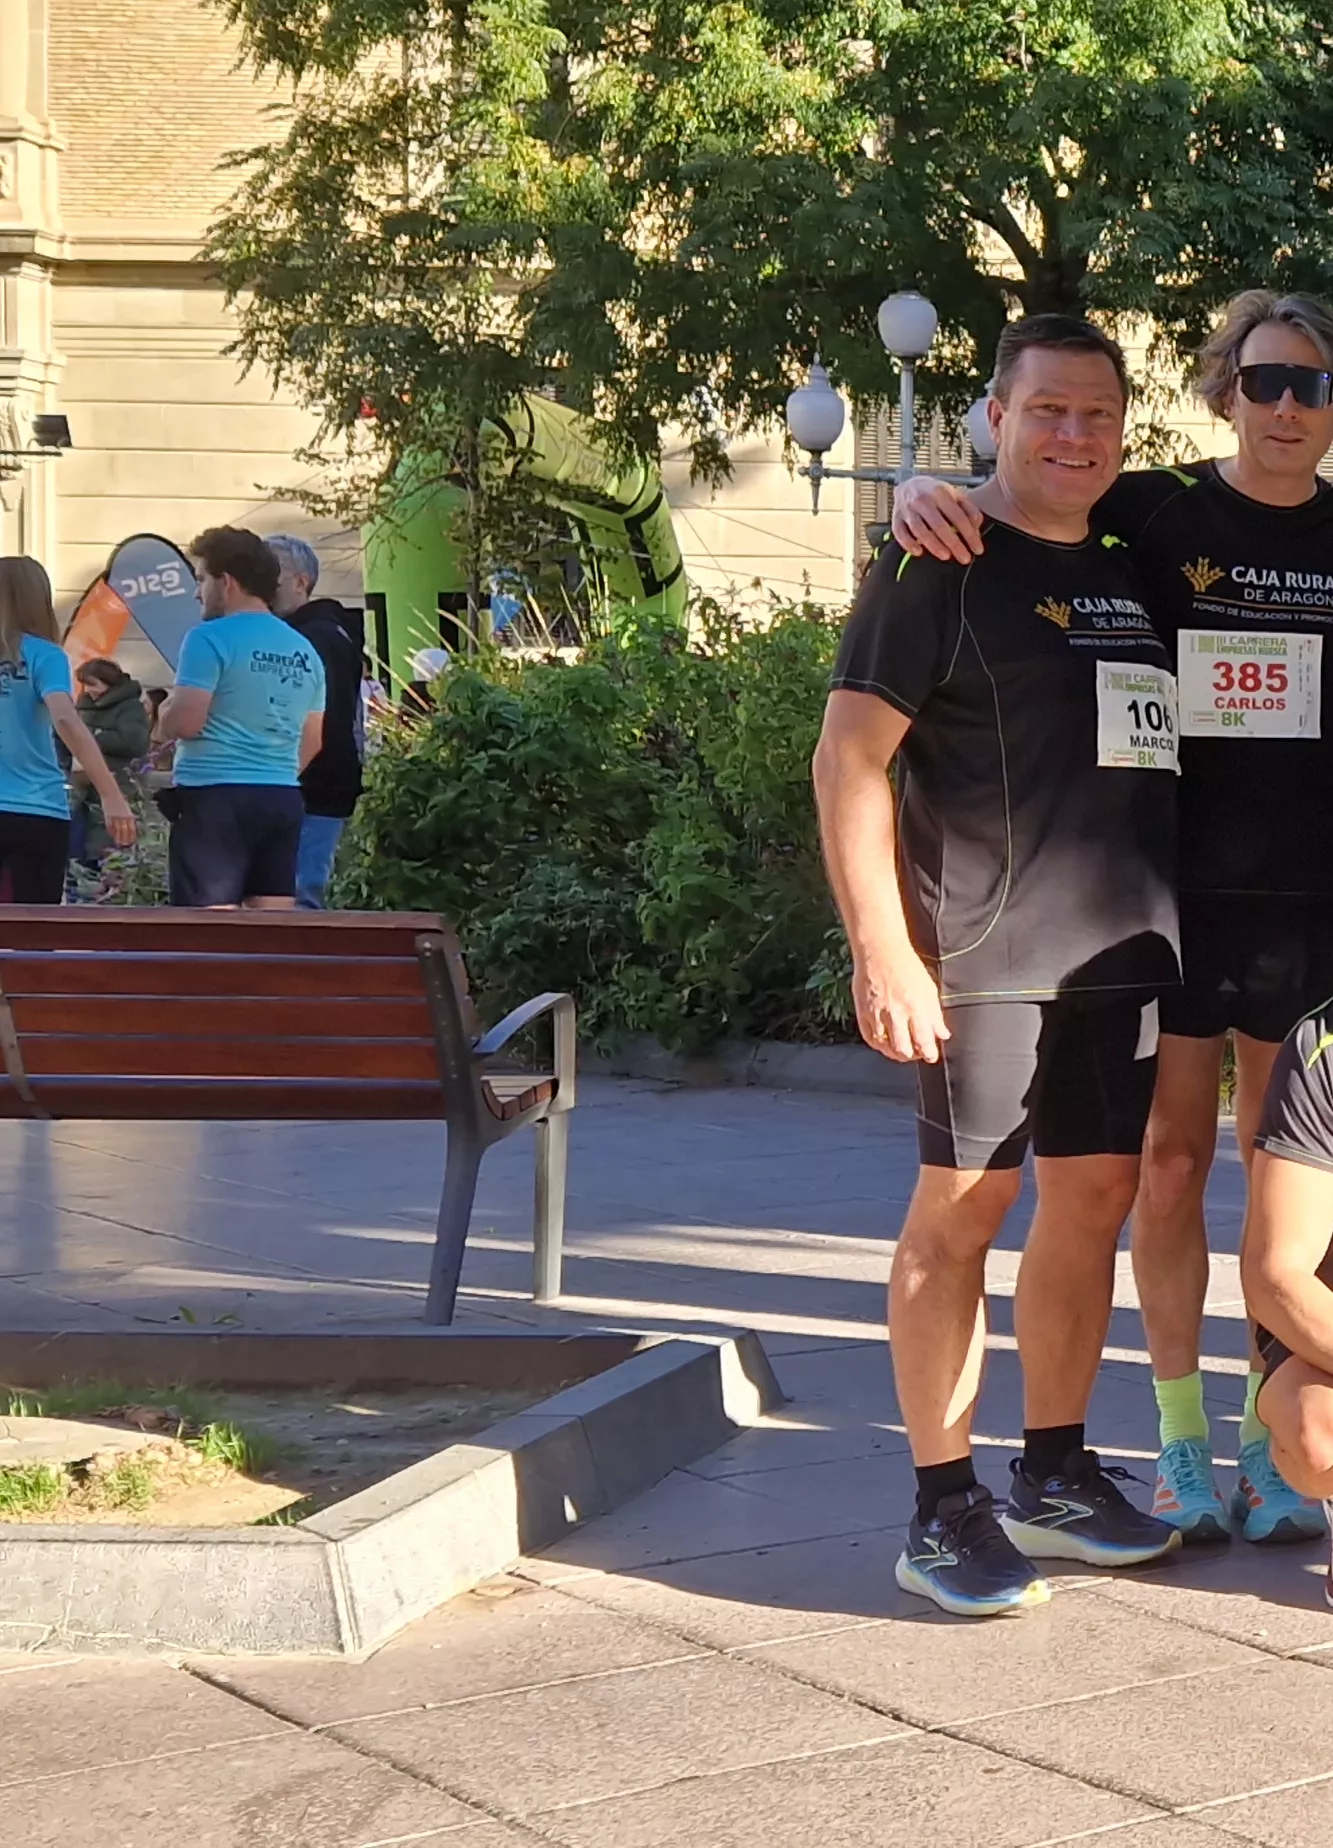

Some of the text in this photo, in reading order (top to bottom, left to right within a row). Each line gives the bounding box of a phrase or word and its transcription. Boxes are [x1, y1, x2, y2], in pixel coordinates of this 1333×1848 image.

[1231, 566, 1280, 587] CAJA
[1243, 587, 1265, 601] DE
[1073, 598, 1110, 614] CAJA
[1192, 601, 1226, 615] FONDO
[1093, 617, 1107, 629] DE
[1229, 636, 1288, 648] CARRERA
[1212, 661, 1288, 694] 385
[1214, 697, 1286, 711] CARLOS
[1127, 700, 1173, 734] 106
[1221, 712, 1246, 726] 8K
[1137, 751, 1157, 766] 8K
